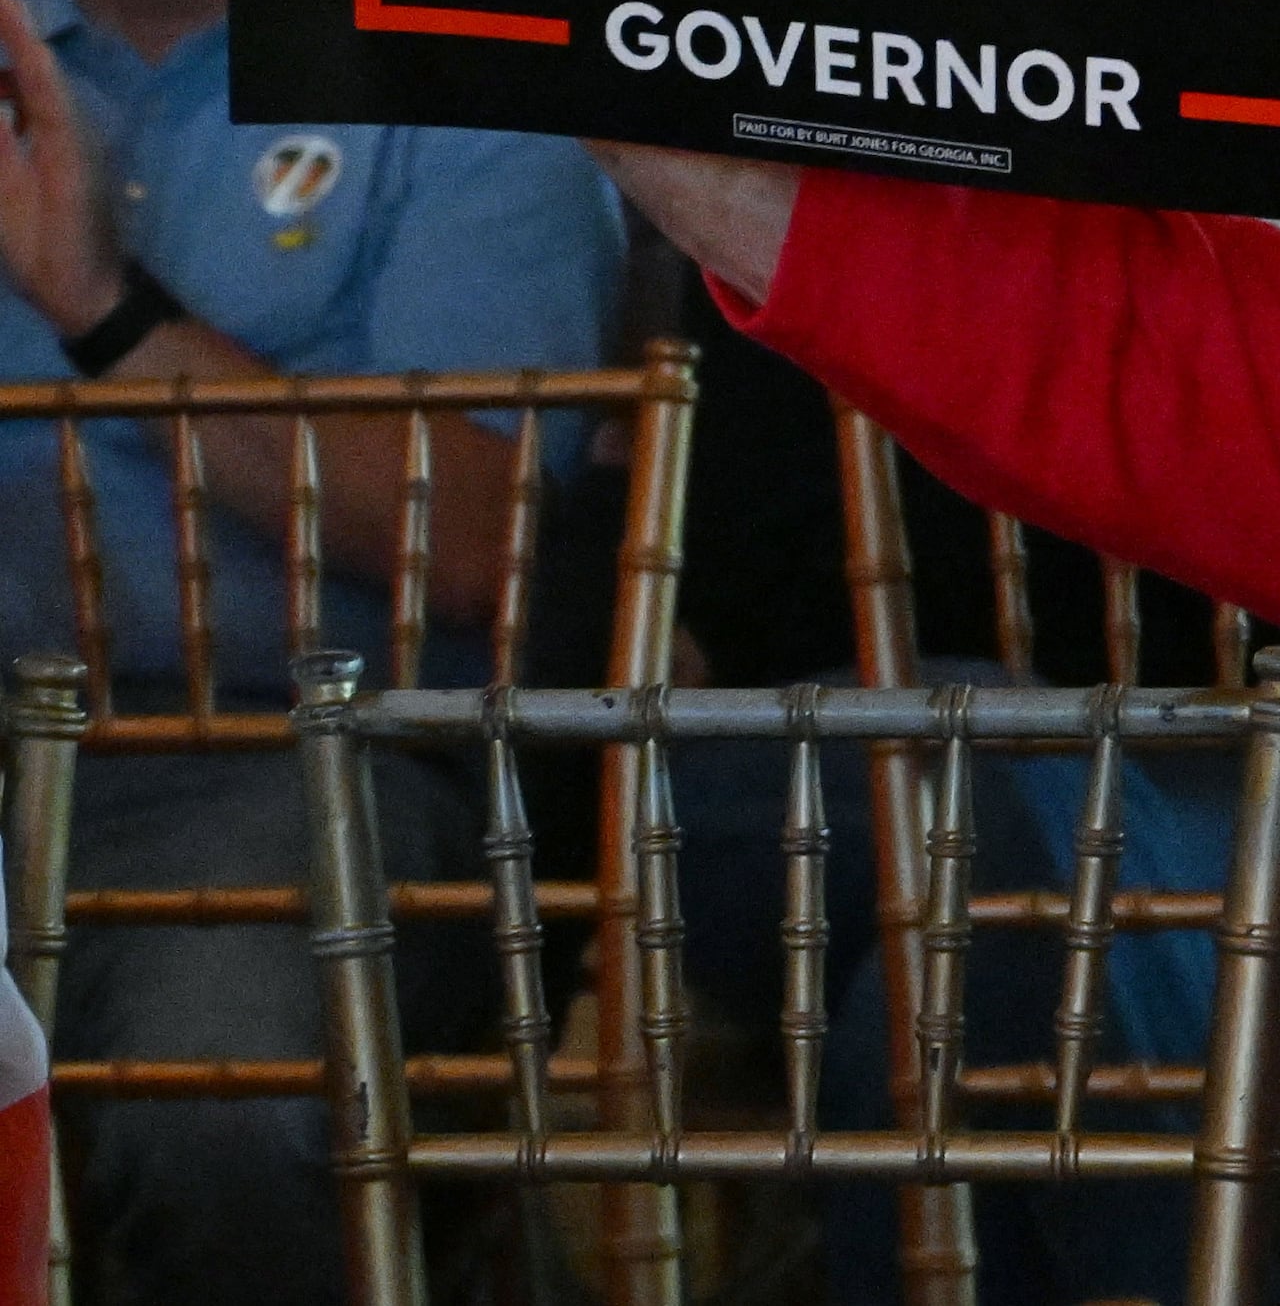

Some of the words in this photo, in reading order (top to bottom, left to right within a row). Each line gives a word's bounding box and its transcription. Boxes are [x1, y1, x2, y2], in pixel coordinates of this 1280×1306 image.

[605, 1, 1141, 131] GOVERNOR
[738, 120, 767, 136] PAID
[769, 124, 796, 140] FOR
[797, 128, 814, 142] BY
[815, 130, 849, 147] BURT
[850, 134, 890, 152] JONES
[892, 140, 917, 156] FOR
